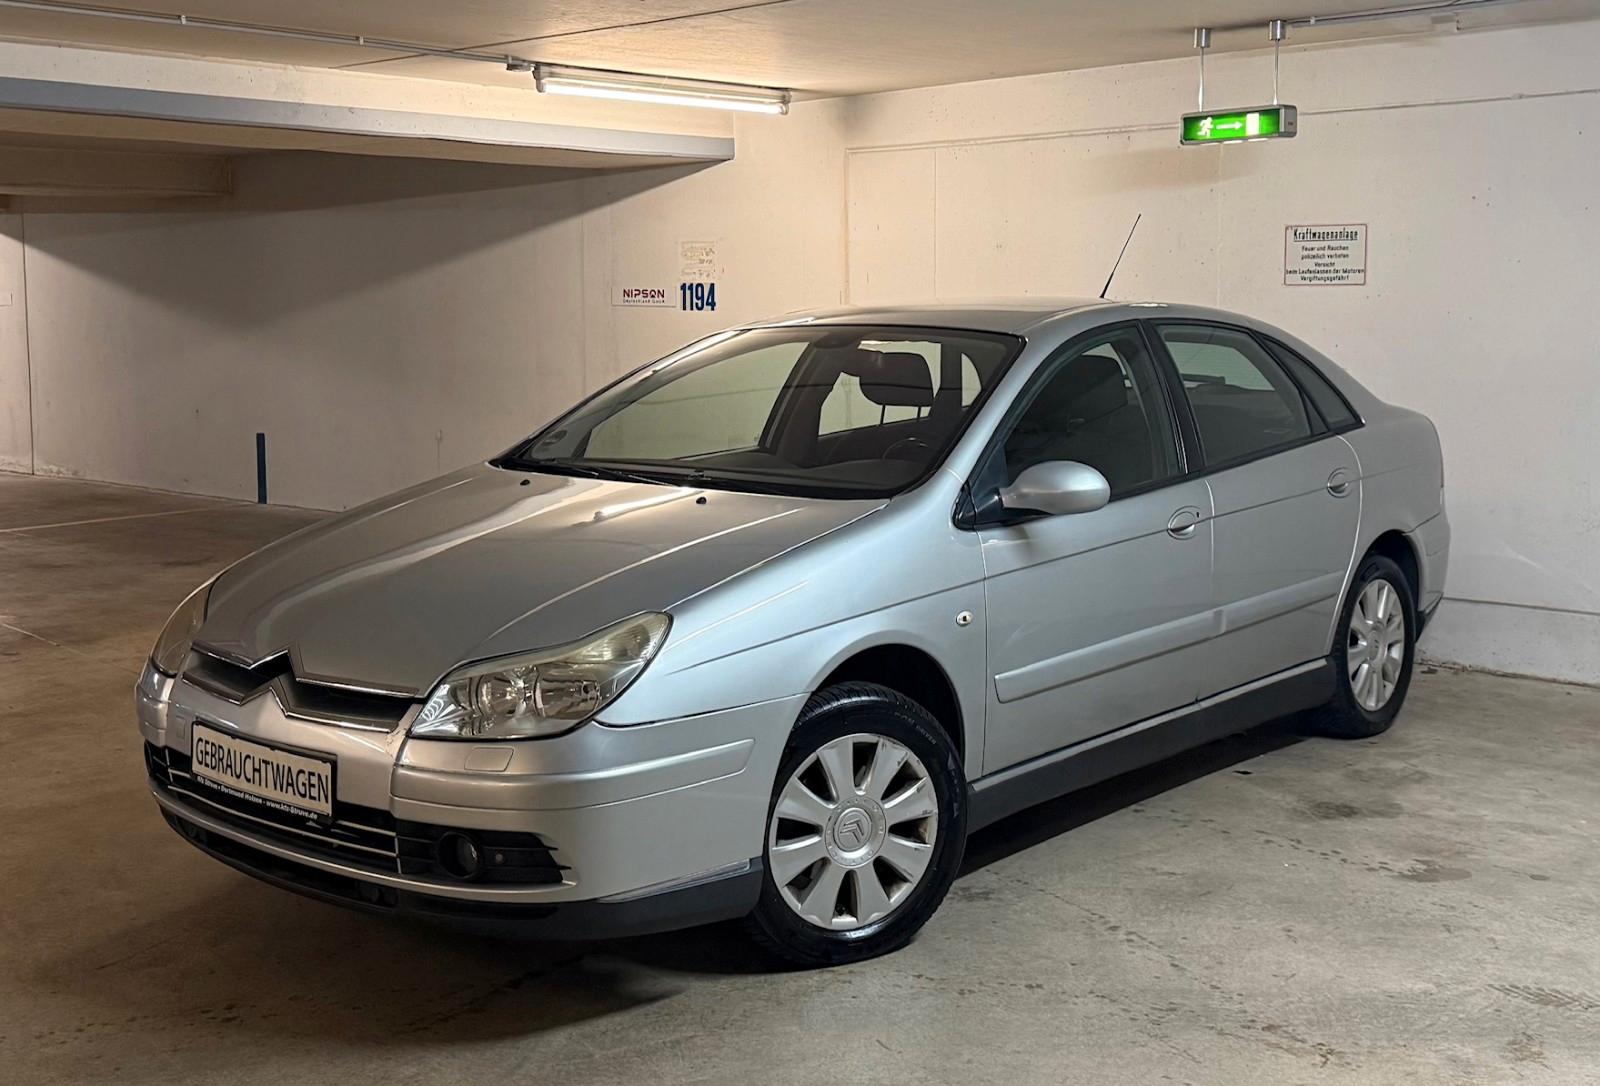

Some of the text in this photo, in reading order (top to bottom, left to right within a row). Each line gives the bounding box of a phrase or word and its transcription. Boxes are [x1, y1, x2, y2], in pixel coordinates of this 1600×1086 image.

[1293, 227, 1358, 241] Kraftwagenanlage
[623, 289, 665, 298] NIPSON
[680, 282, 716, 311] 1194
[195, 737, 329, 804] GEBRAUCHTWAGEN
